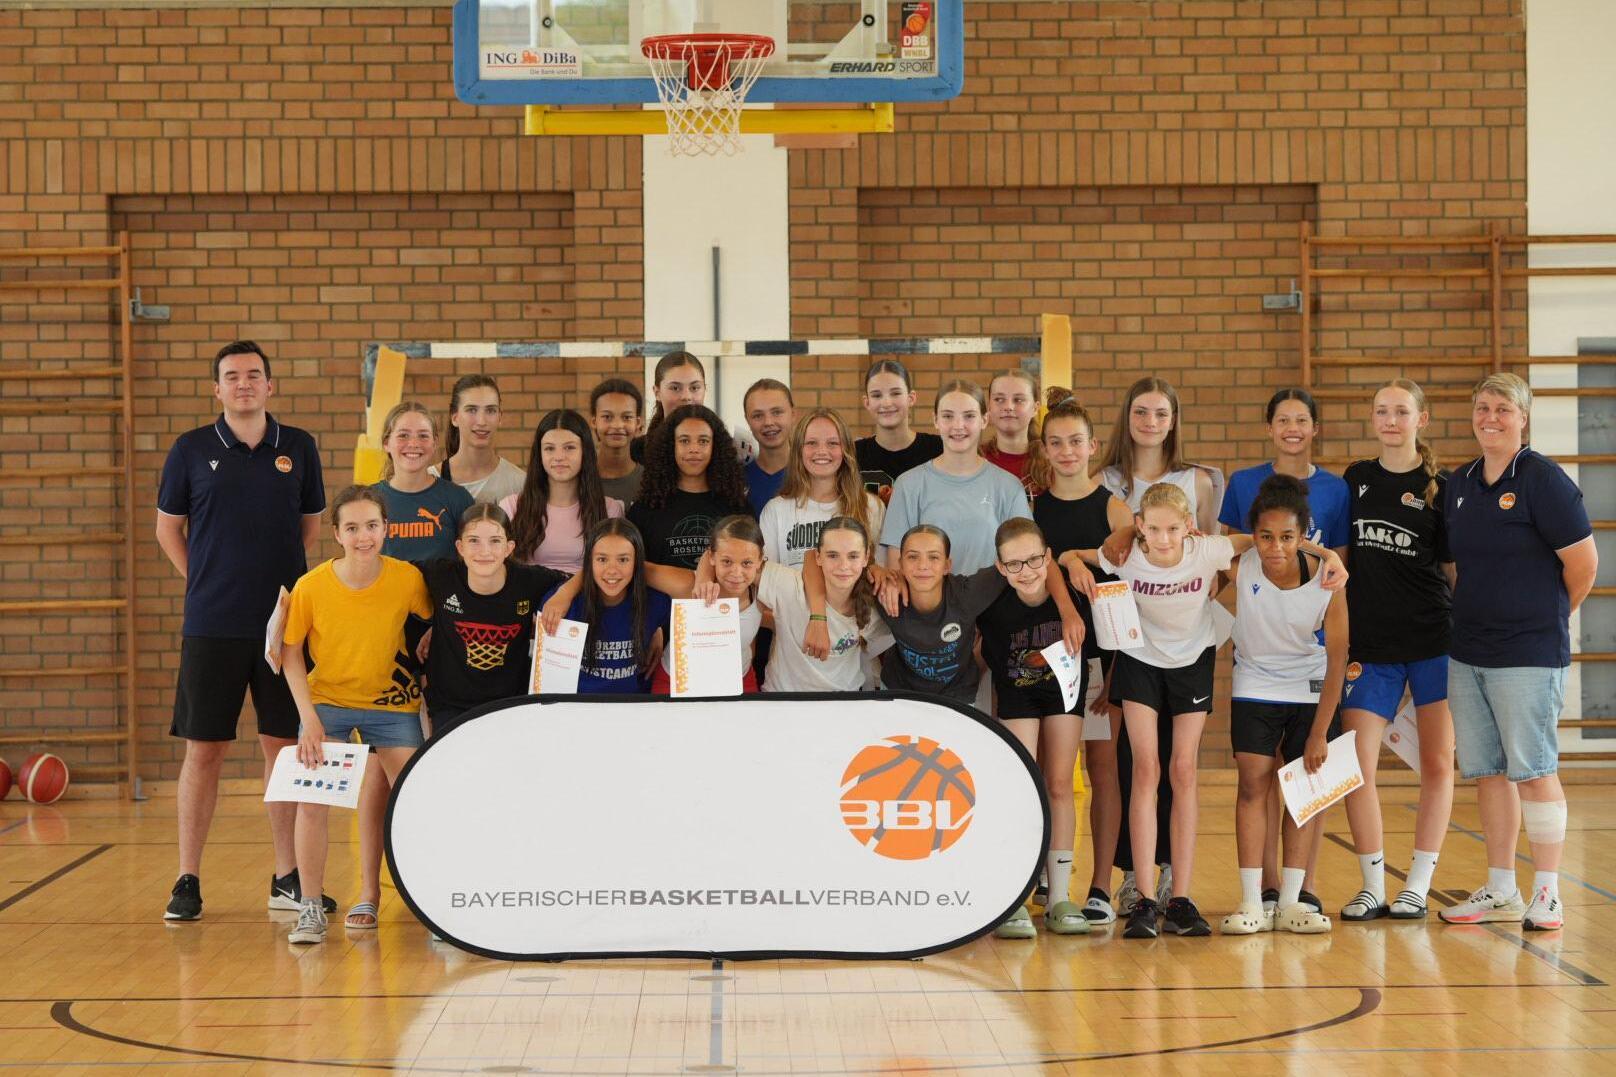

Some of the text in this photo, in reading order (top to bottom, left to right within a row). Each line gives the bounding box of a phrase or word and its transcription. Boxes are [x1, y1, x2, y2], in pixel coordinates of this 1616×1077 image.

[903, 35, 929, 47] DBB
[487, 52, 577, 65] ING DiBa
[830, 61, 934, 73] ERHARD SPORT
[388, 521, 434, 539] PUMA
[669, 537, 710, 547] BASKETB
[936, 890, 973, 906] e.V.
